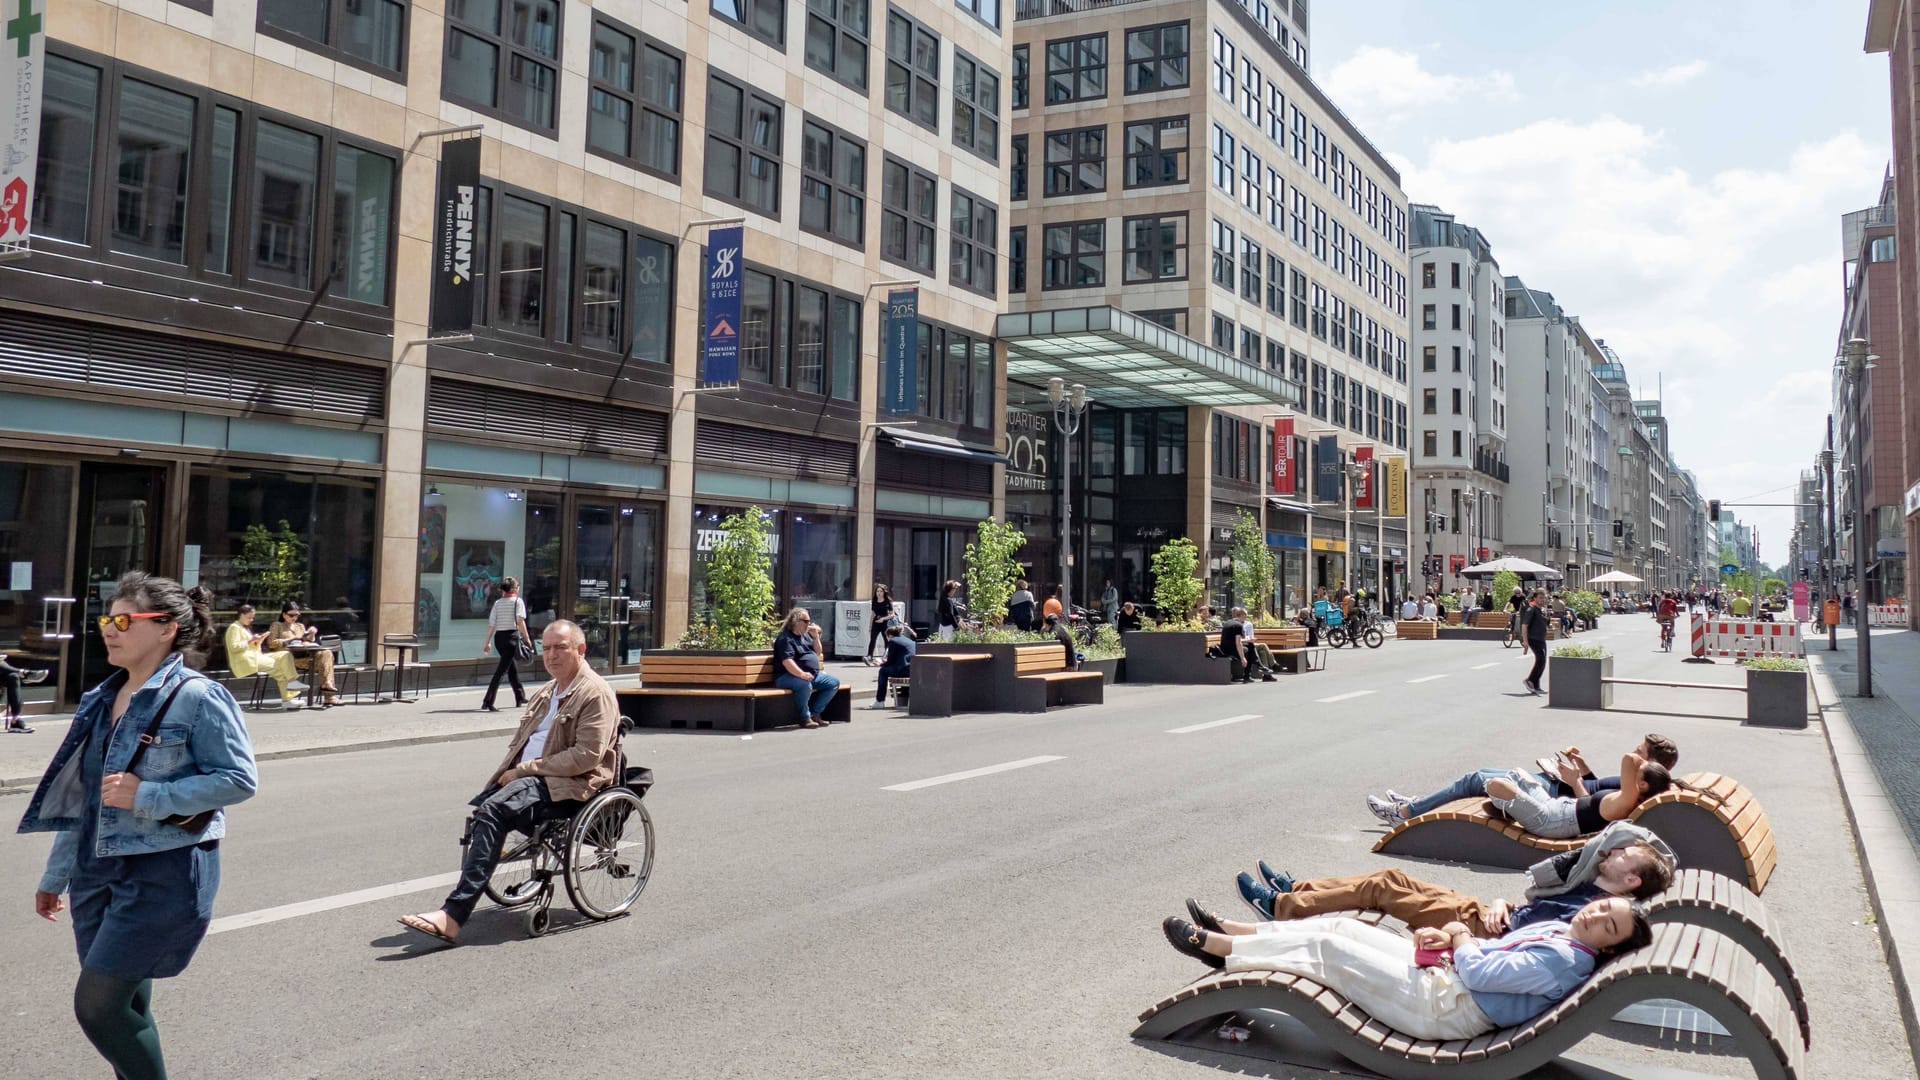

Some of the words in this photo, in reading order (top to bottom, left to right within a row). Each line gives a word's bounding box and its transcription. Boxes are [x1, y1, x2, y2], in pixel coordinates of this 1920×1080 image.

[19, 60, 33, 146] APOTHEKE
[444, 200, 454, 272] Friedrichstraße
[455, 185, 474, 282] PENNY
[892, 303, 915, 314] 205
[899, 350, 905, 359] im
[1006, 407, 1047, 432] UARTIER
[1277, 435, 1287, 477] DERTOUR
[1005, 475, 1046, 490] TADTMITTE
[1356, 460, 1367, 497] REE
[846, 609, 861, 618] FREE
